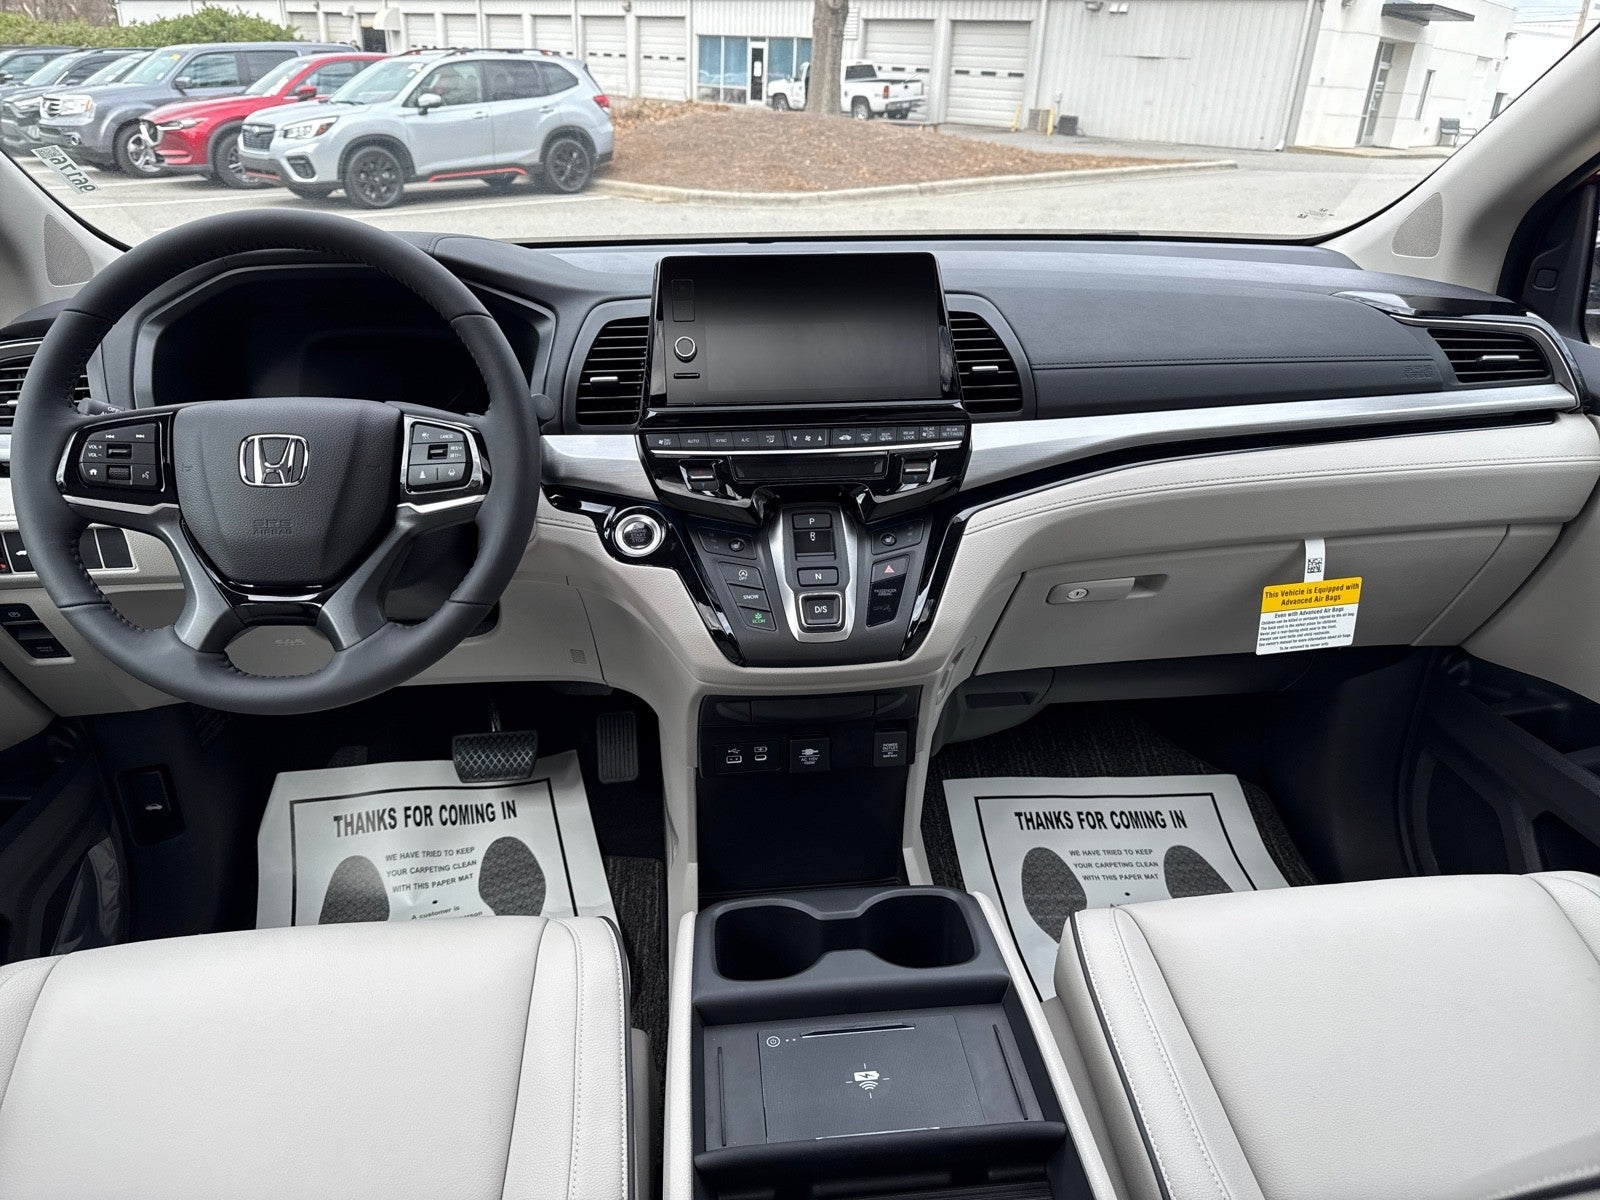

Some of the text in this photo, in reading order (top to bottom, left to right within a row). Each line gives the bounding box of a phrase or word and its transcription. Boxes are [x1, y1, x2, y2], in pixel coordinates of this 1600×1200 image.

[1280, 589, 1305, 597] Vehicle
[1314, 584, 1344, 595] Equipped
[1281, 597, 1312, 606] Advanced
[333, 800, 517, 837] THANKS FOR COMING IN
[1014, 810, 1188, 830] THANKS FOR COMING IN
[400, 851, 420, 859] HAVE
[387, 860, 477, 877] YOUR CARPETING CLEAN
[392, 884, 411, 892] WITH
[432, 878, 456, 888] PAPER
[458, 873, 474, 881] MAT
[419, 908, 451, 918] customer
